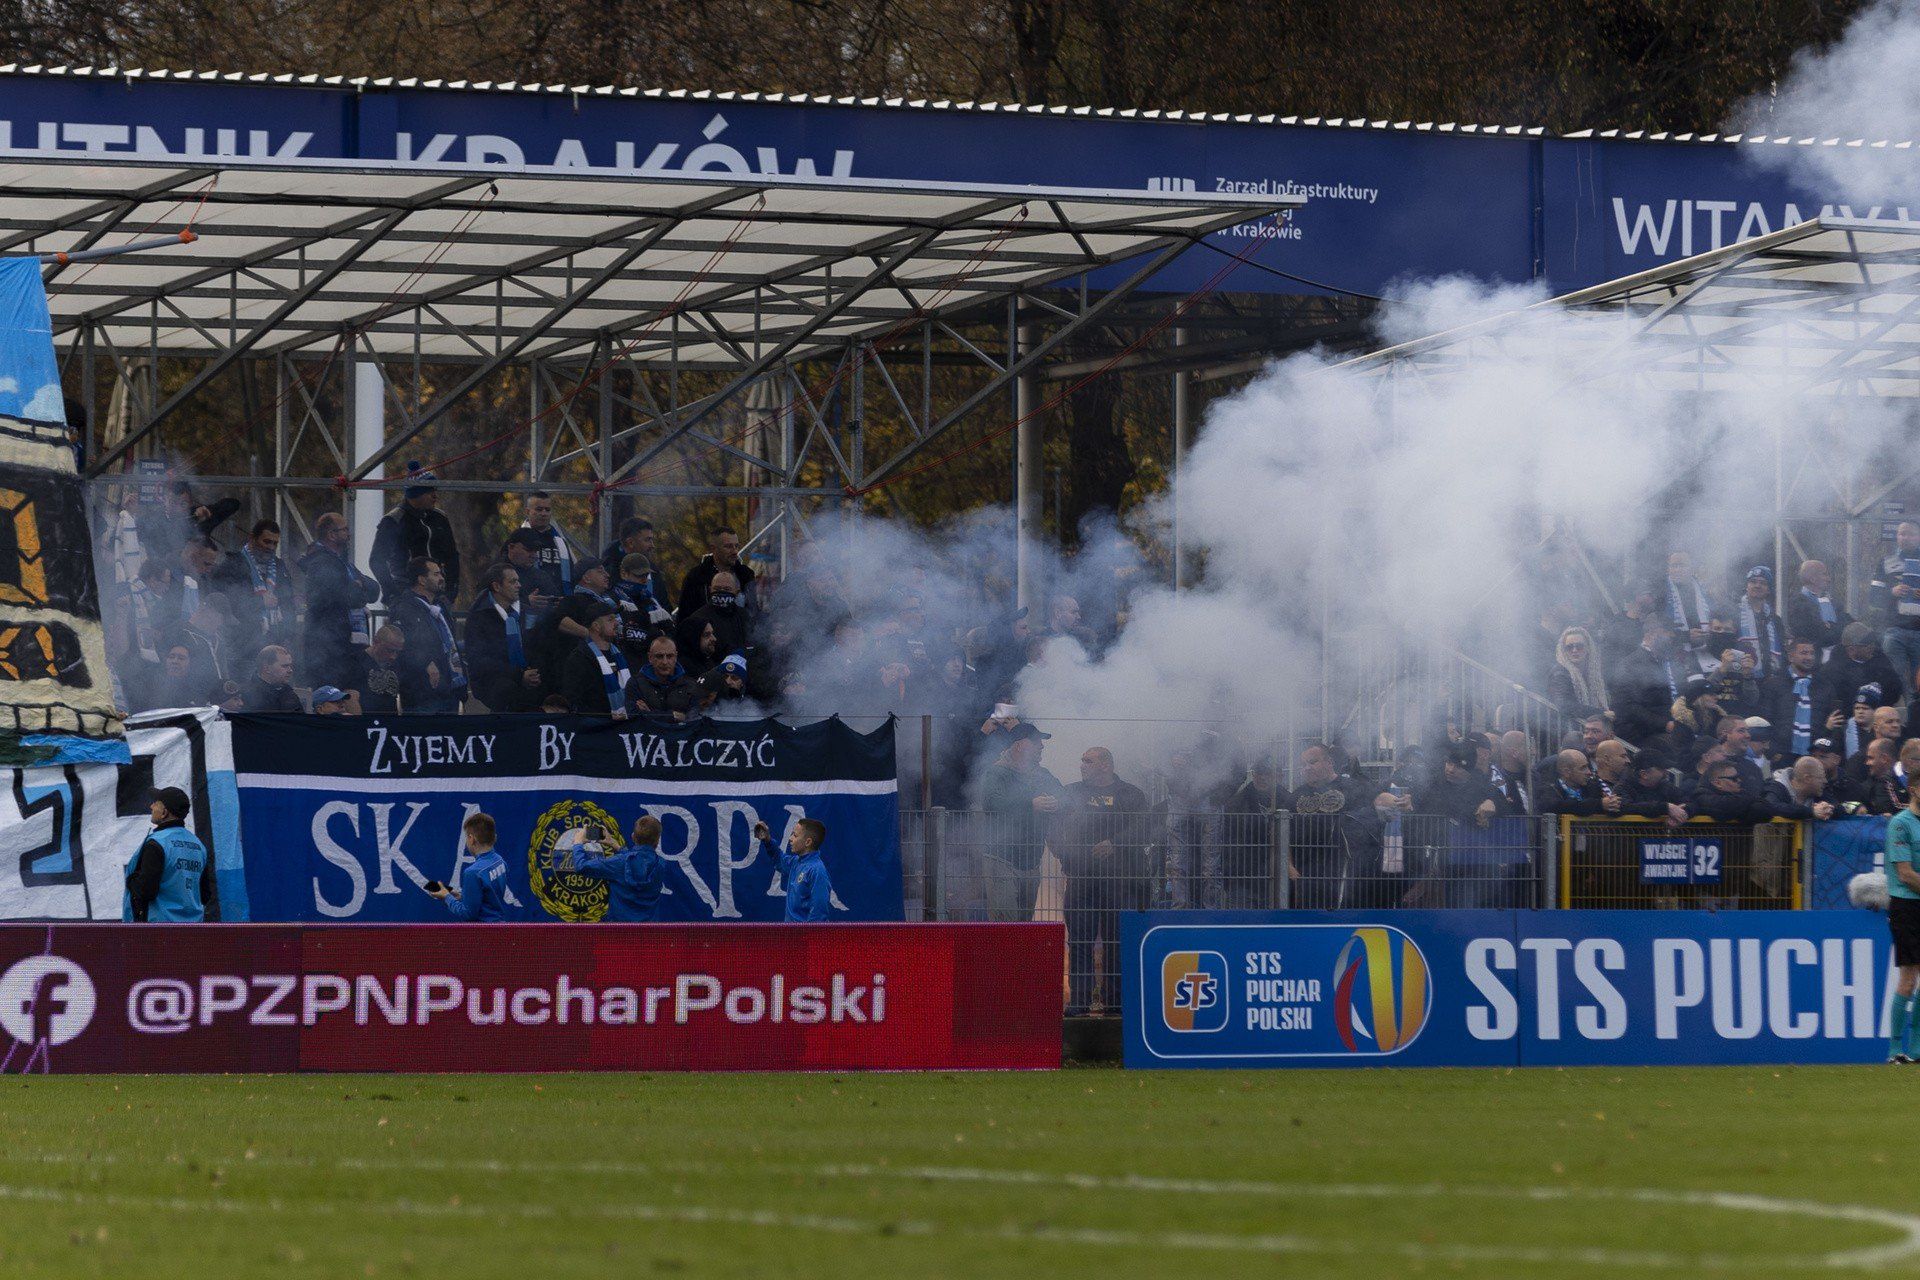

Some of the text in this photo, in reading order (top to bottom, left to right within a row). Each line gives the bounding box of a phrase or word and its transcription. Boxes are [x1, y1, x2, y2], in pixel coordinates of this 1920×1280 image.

[1273, 180, 1379, 204] Infrastruktury
[1232, 221, 1302, 240] Krakowie
[540, 828, 559, 870] KLUB
[1644, 842, 1687, 860] WYJŚCIE
[1694, 845, 1719, 876] 32
[1644, 864, 1687, 878] AWARYJNE
[1246, 952, 1282, 975] STS
[1173, 972, 1218, 1011] STS
[1246, 978, 1322, 1003] PUCHAR
[1465, 938, 1627, 1041] STS
[127, 972, 887, 1034] @PZPNPucharPolski
[1247, 1007, 1313, 1030] POLSKI
